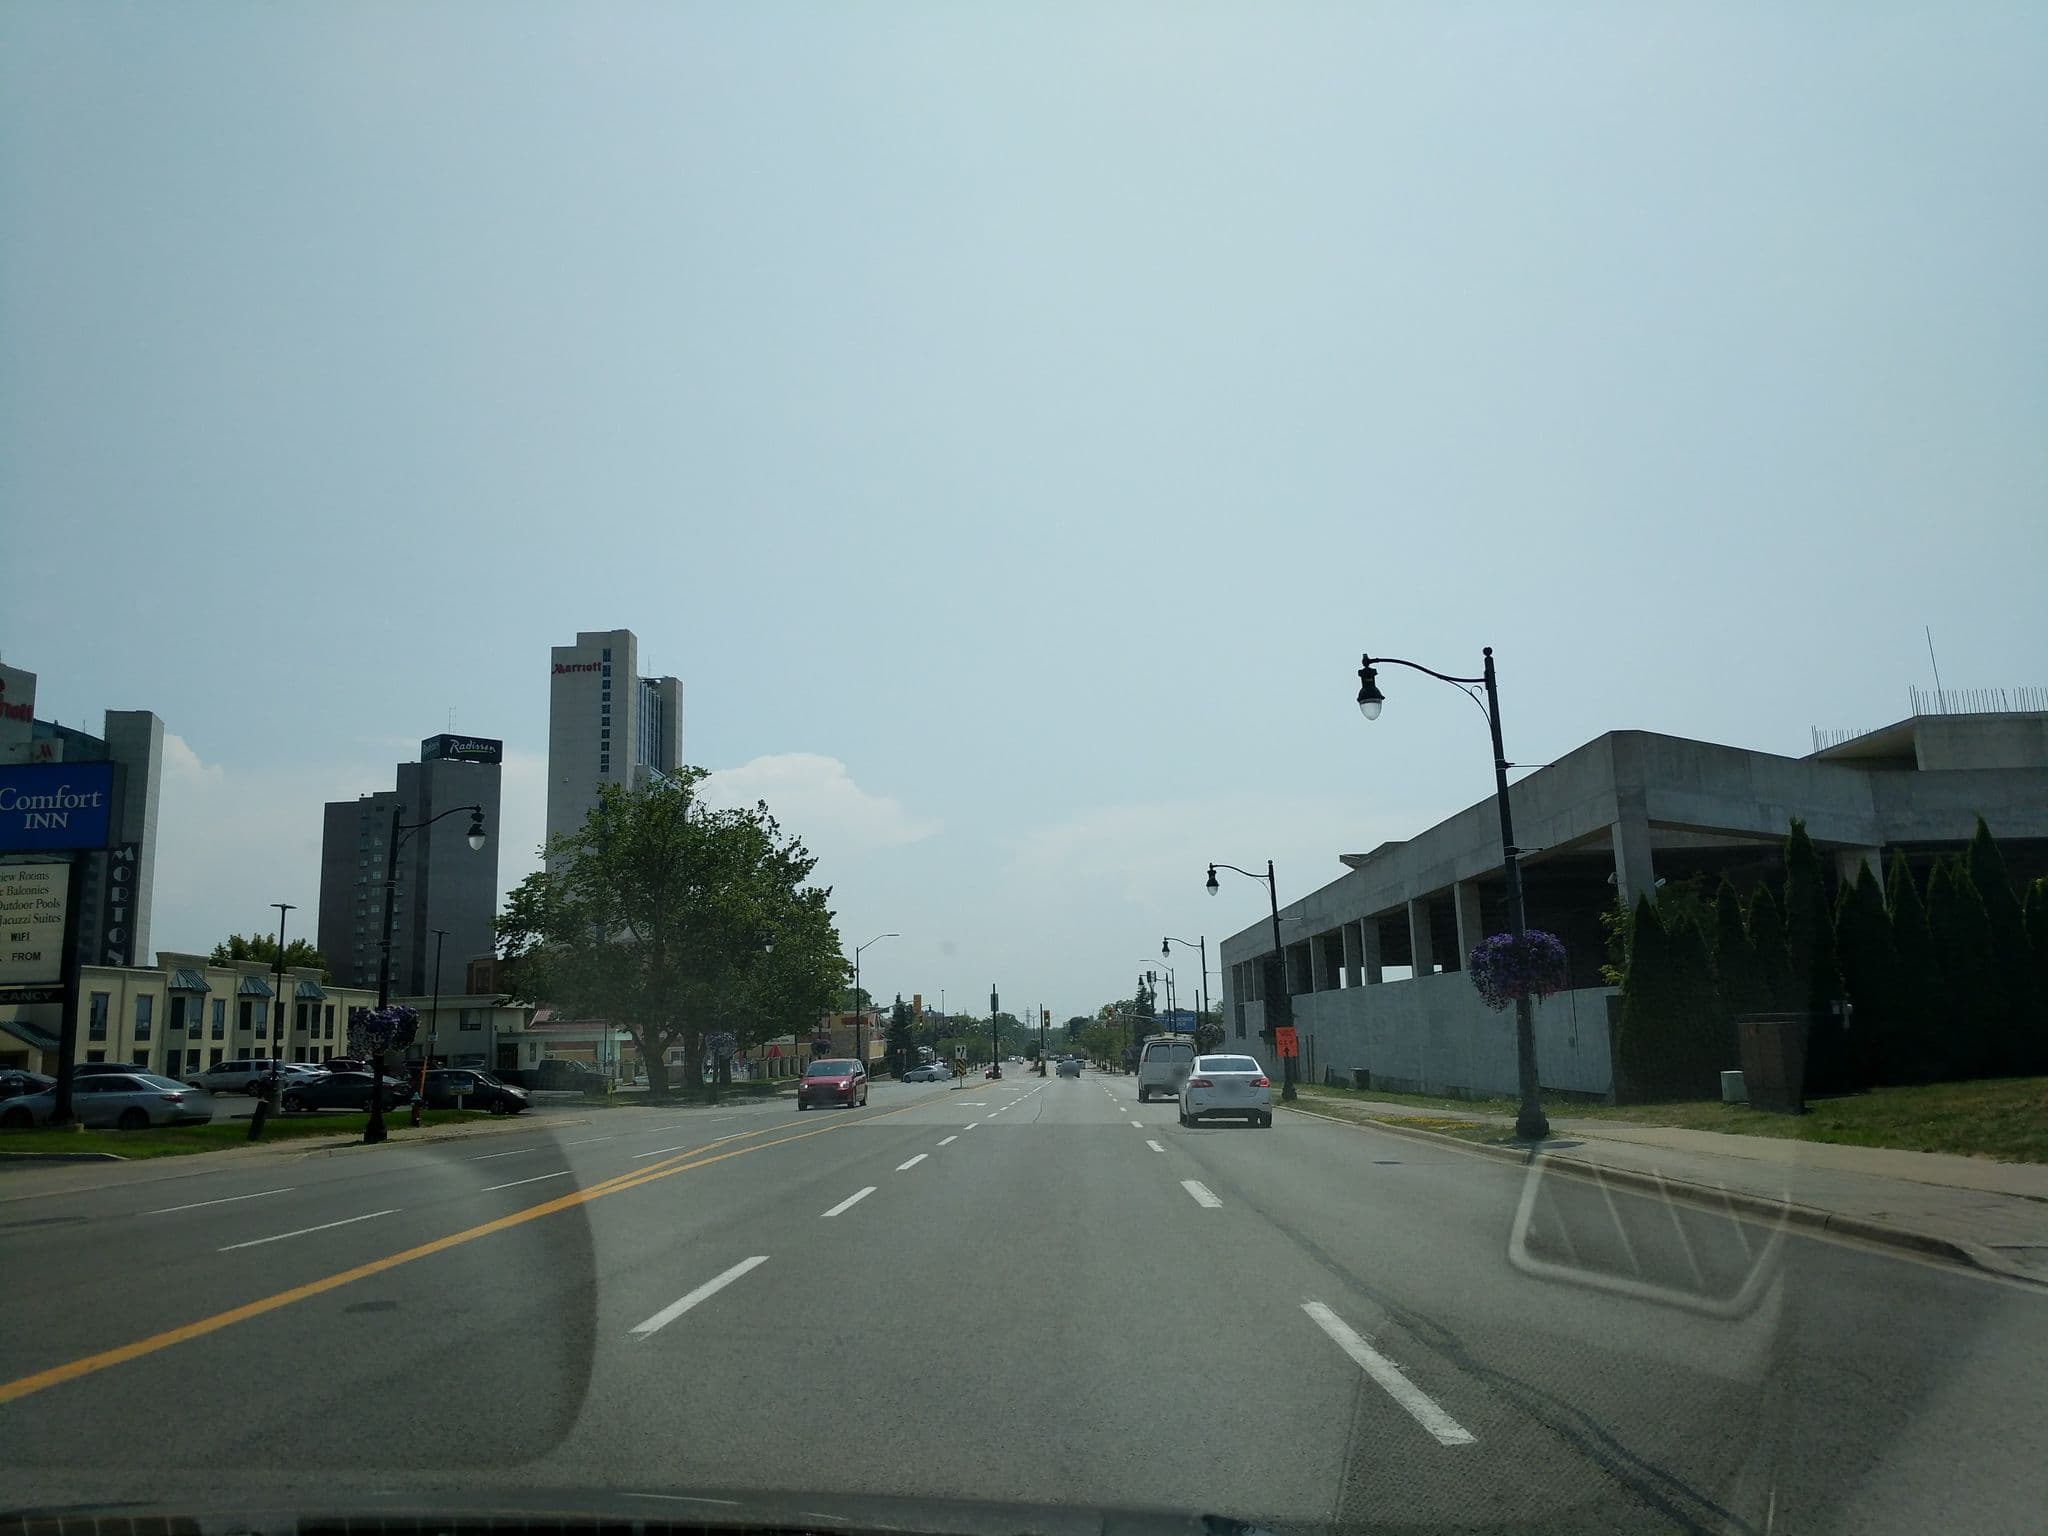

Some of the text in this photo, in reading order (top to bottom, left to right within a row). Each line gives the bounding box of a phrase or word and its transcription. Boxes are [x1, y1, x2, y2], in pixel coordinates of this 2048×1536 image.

[551, 662, 602, 674] Marriott
[450, 739, 497, 754] Radisson
[0, 784, 103, 811] Comfort
[24, 812, 69, 829] INN
[19, 870, 50, 881] Rooms
[7, 885, 49, 896] Balconies
[36, 897, 62, 909] Pools
[33, 912, 62, 924] Suites
[11, 932, 30, 942] WIFI
[12, 952, 41, 961] FROM
